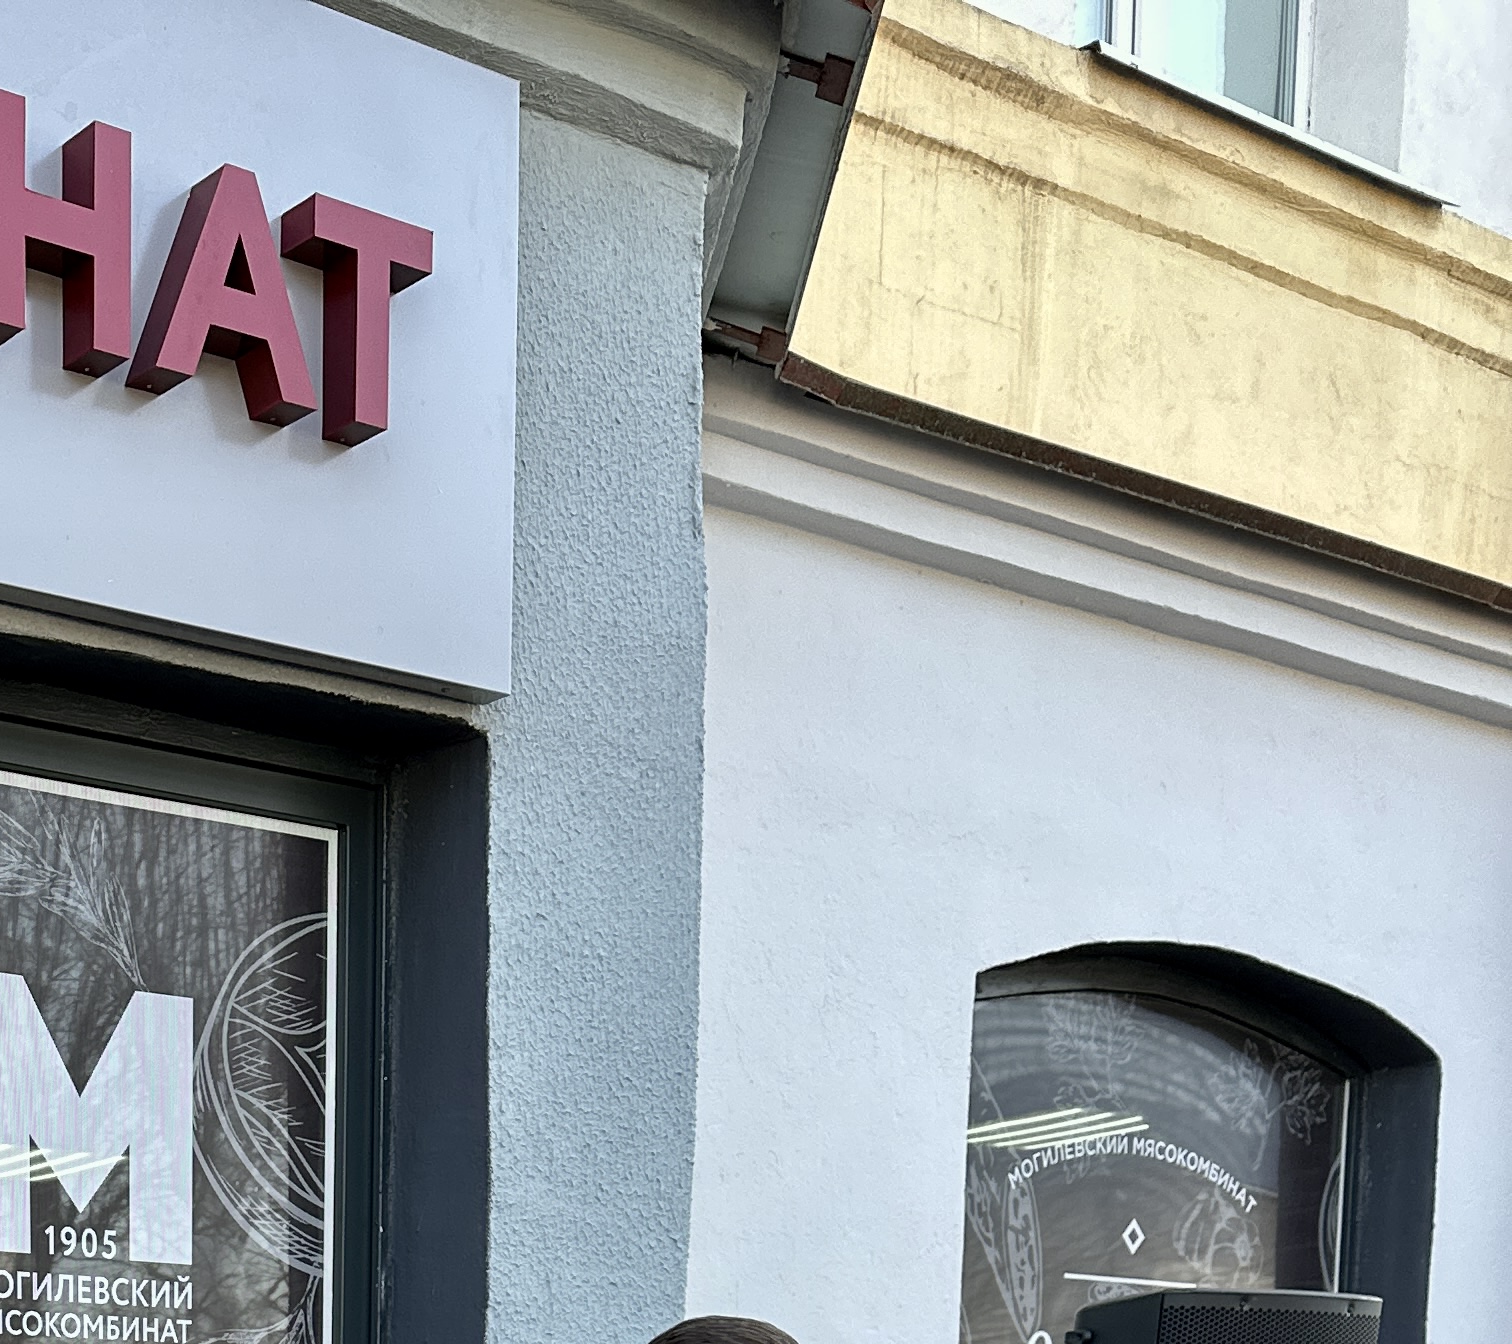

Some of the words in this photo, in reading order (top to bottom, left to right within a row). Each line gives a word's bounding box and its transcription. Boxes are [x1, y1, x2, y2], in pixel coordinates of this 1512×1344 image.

[1008, 1131, 1128, 1189] МОГИЛЕВСКИЙ
[1132, 1136, 1257, 1213] МЯСОКОМБИНАТ
[44, 1225, 117, 1260] 1905
